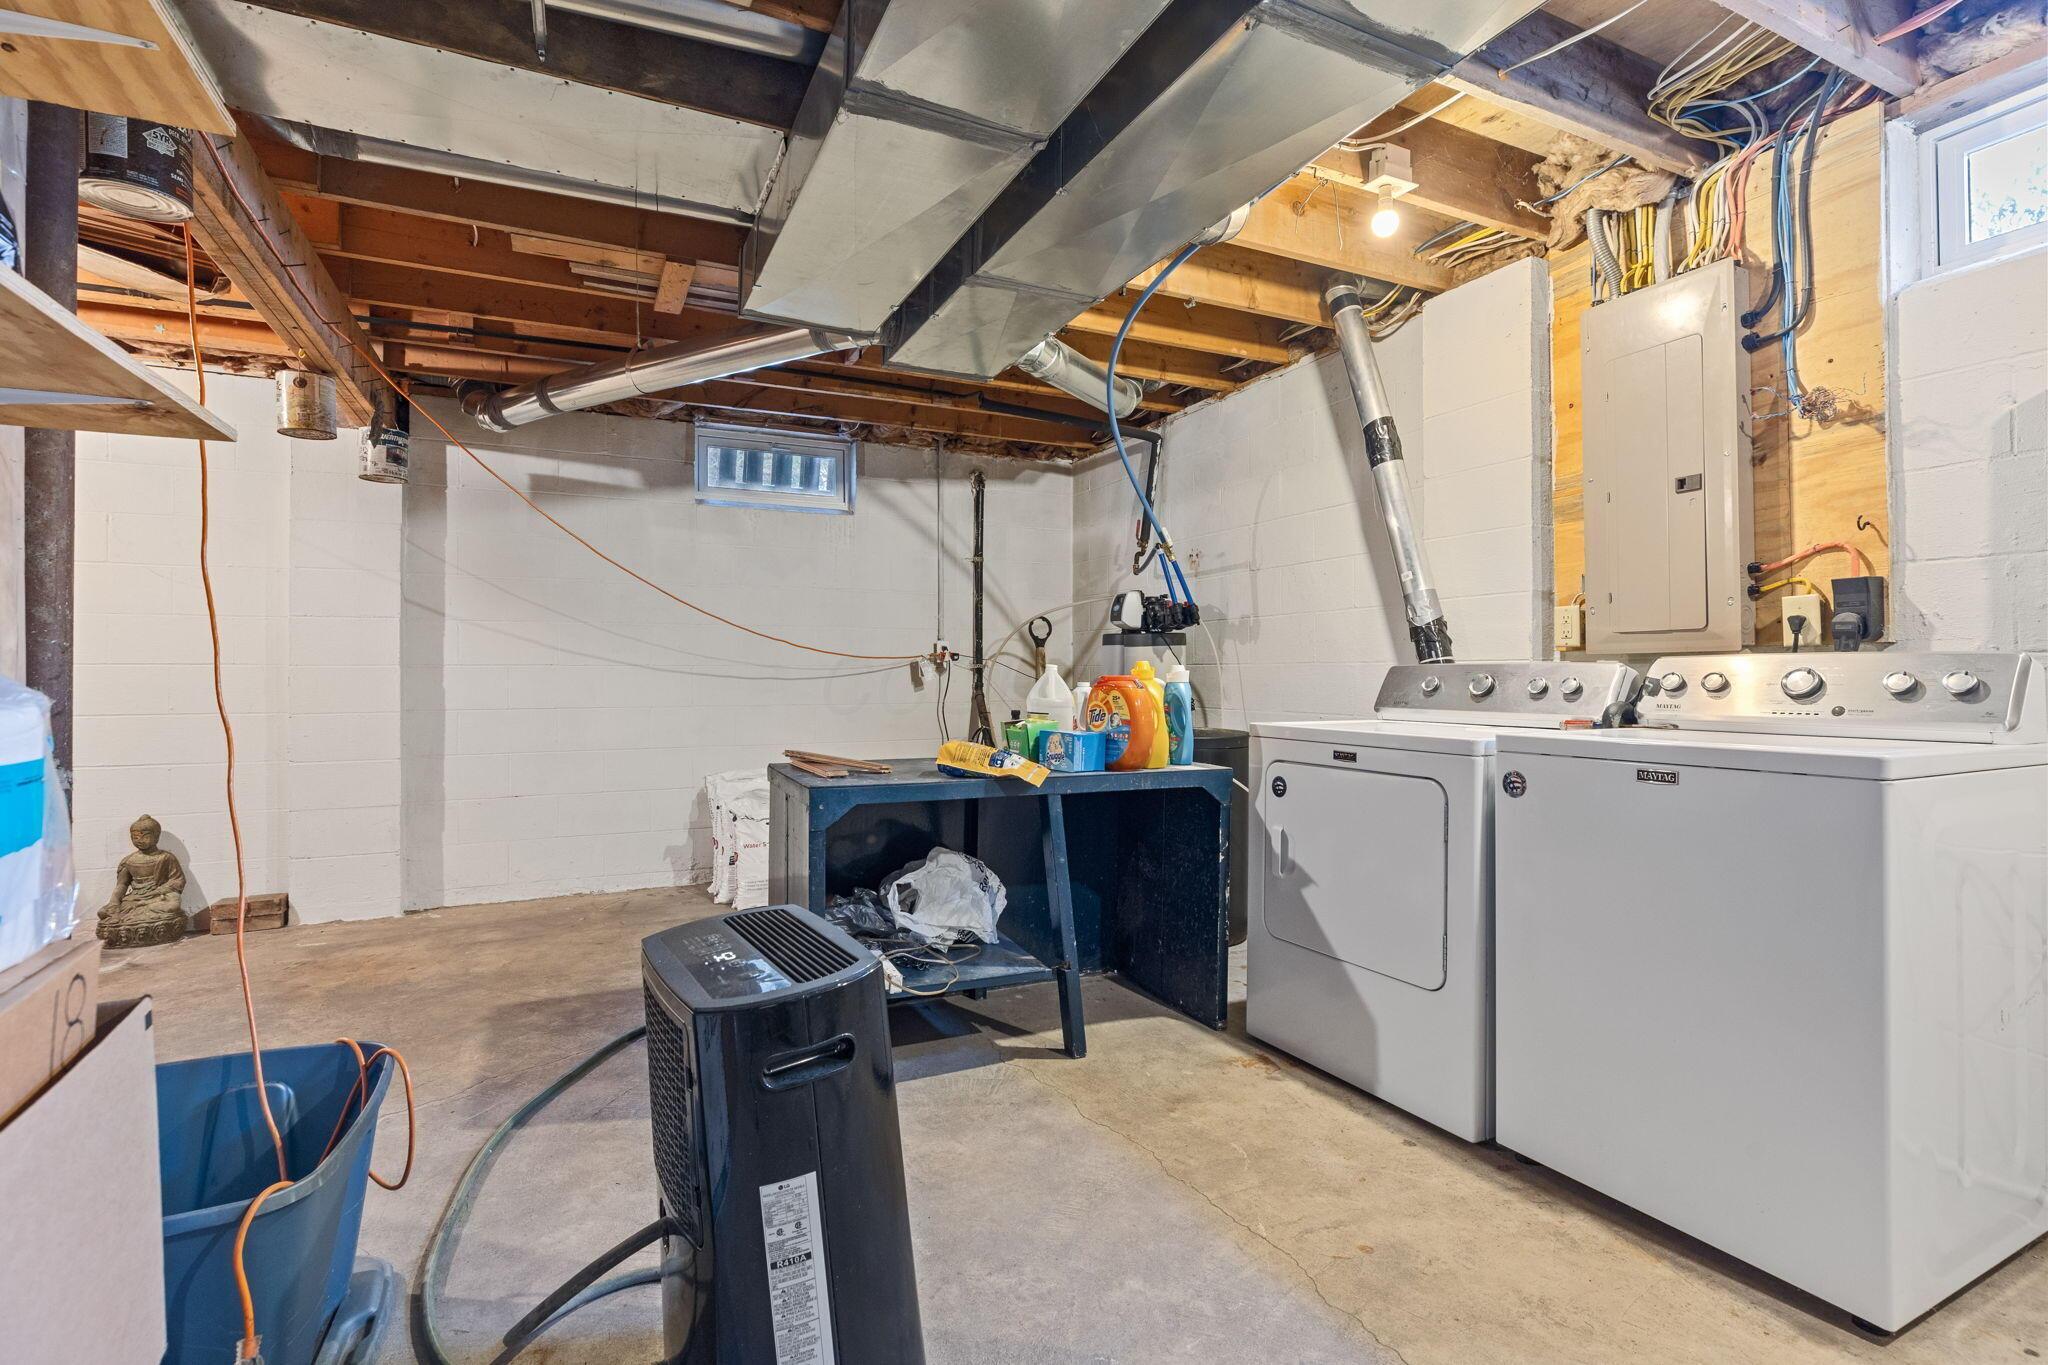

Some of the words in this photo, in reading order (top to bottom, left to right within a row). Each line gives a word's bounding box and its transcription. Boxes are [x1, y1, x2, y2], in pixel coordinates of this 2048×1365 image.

[1088, 707, 1106, 725] Tide
[1046, 751, 1065, 763] Snuggle
[1638, 771, 1675, 782] MAYTAG
[776, 1254, 807, 1269] R410A
